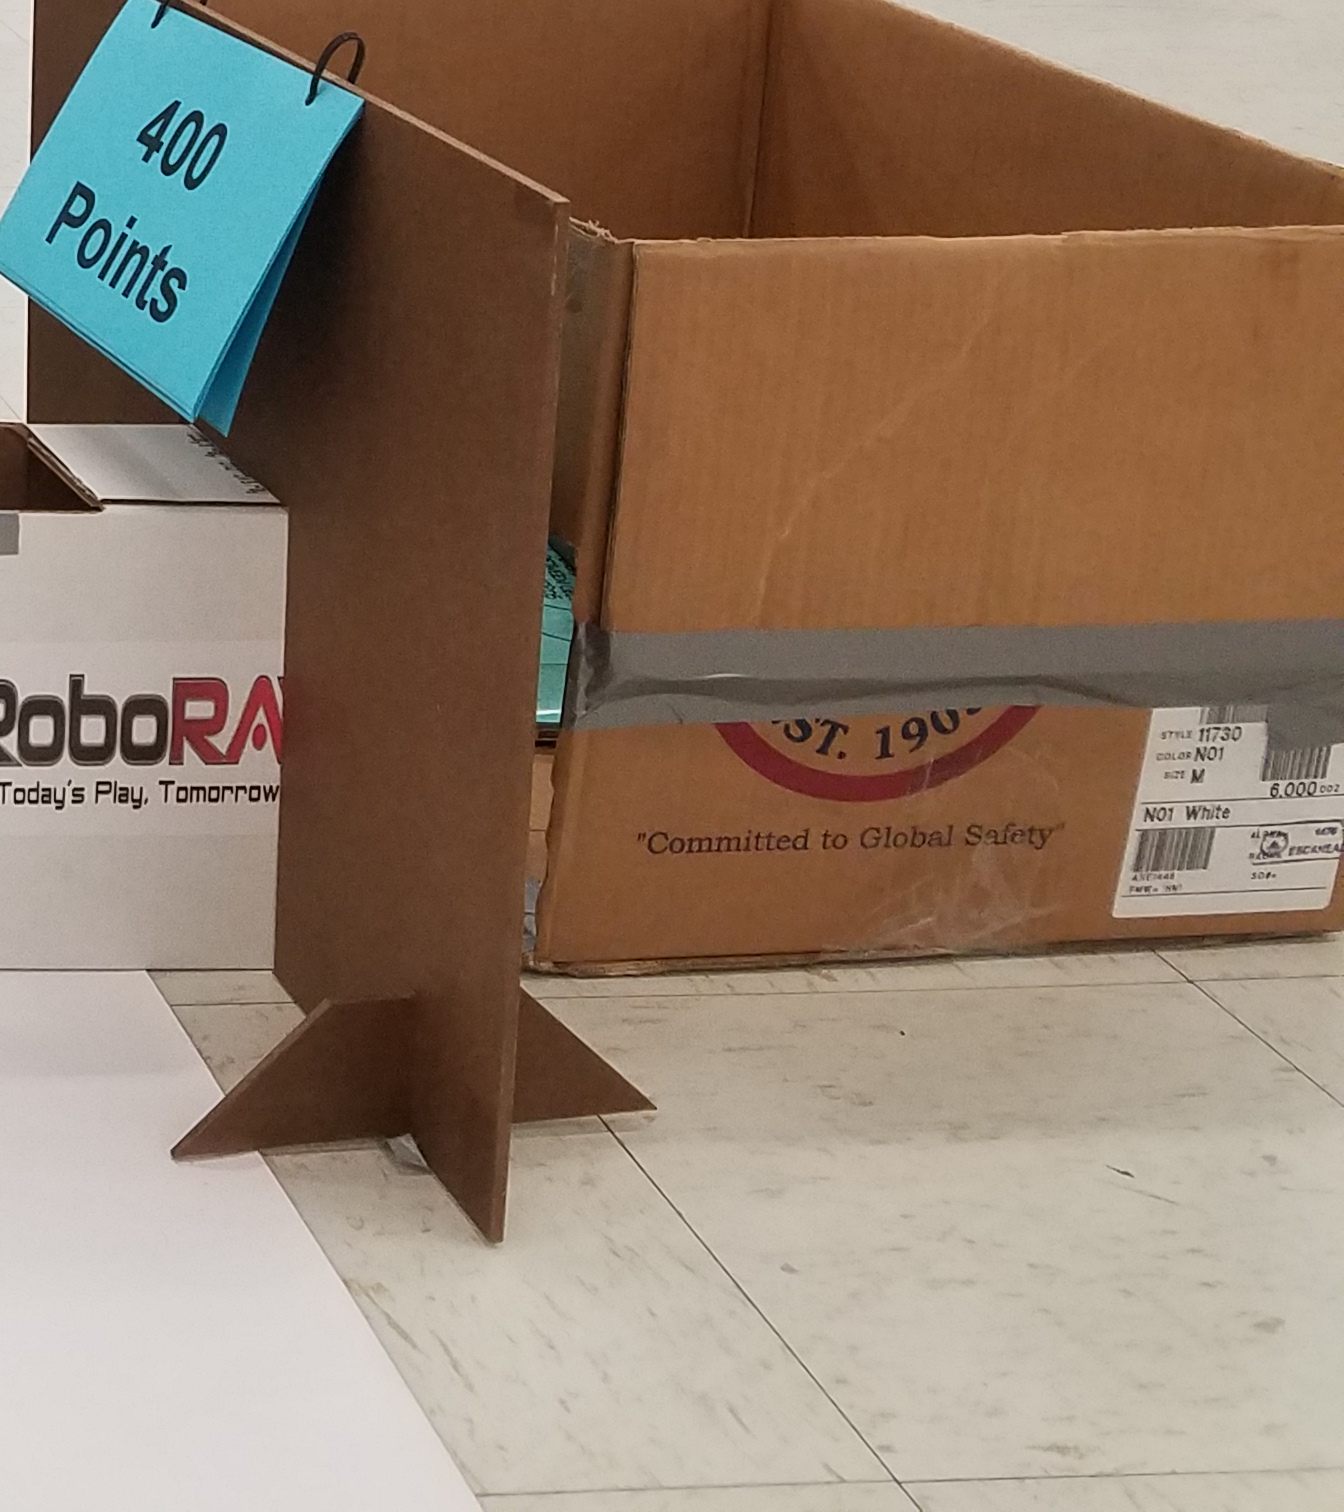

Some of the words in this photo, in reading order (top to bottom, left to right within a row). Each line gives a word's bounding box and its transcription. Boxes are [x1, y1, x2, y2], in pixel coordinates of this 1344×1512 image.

[135, 99, 228, 191] 400
[45, 180, 188, 323] Points
[771, 718, 850, 760] ST.
[874, 706, 983, 760] 190
[1198, 725, 1243, 742] 11730
[1156, 751, 1192, 761] COLOR
[1189, 768, 1206, 784] M
[95, 780, 149, 810] Play,
[1269, 781, 1318, 798] 6.000
[1185, 804, 1231, 822] White
[636, 828, 810, 855] "Committed
[821, 829, 849, 851] to
[859, 823, 954, 849] Global
[964, 821, 1067, 851] Safety"
